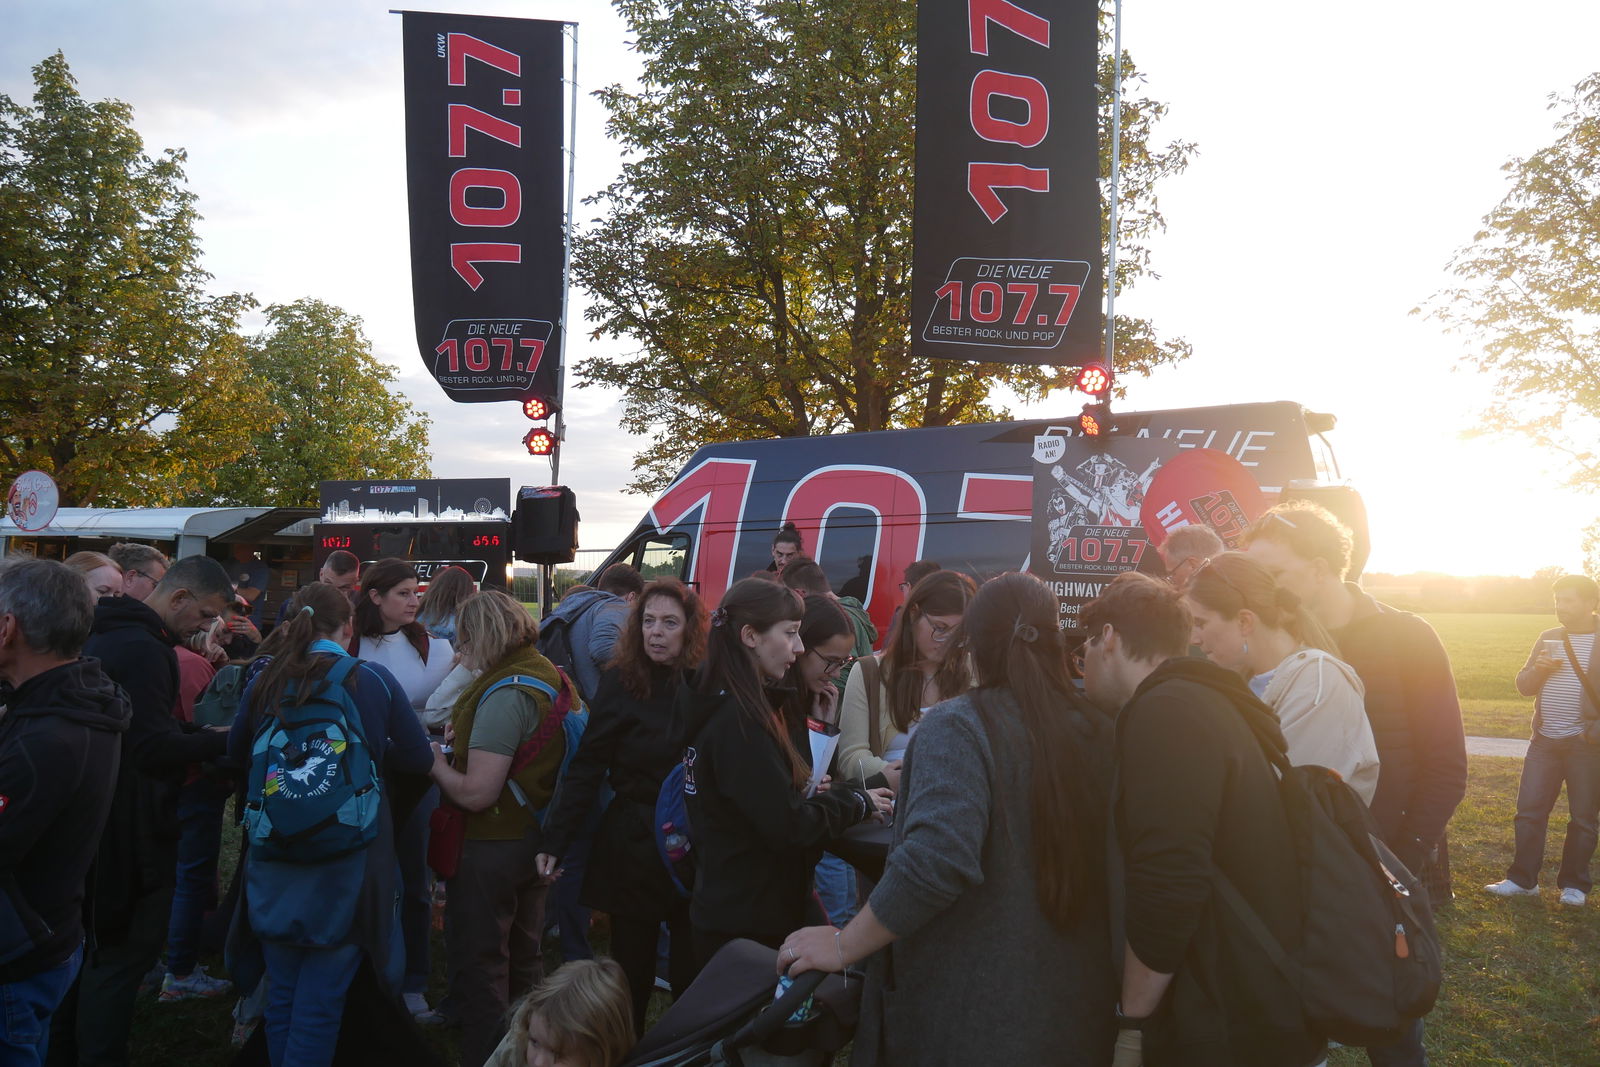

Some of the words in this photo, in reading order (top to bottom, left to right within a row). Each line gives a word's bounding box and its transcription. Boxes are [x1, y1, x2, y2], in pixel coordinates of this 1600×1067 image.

[437, 33, 446, 58] UKW
[447, 32, 522, 292] 107.7
[977, 264, 1005, 278] DIE
[1006, 265, 1053, 279] NEUE
[935, 281, 1081, 326] 107.7
[467, 323, 486, 335] DIE
[488, 323, 523, 335] NEUE
[932, 325, 972, 337] BESTER
[975, 328, 1002, 339] ROCK
[1005, 330, 1029, 341] UND
[1032, 331, 1055, 341] POP
[435, 337, 546, 373] 107.7
[471, 375, 495, 384] ROCK
[496, 374, 515, 383] UND
[1038, 439, 1060, 450] RADIO
[1044, 448, 1057, 459] AN!
[1084, 528, 1101, 537] DIE
[1103, 529, 1130, 538] NEUE
[1061, 537, 1148, 563] 107.7
